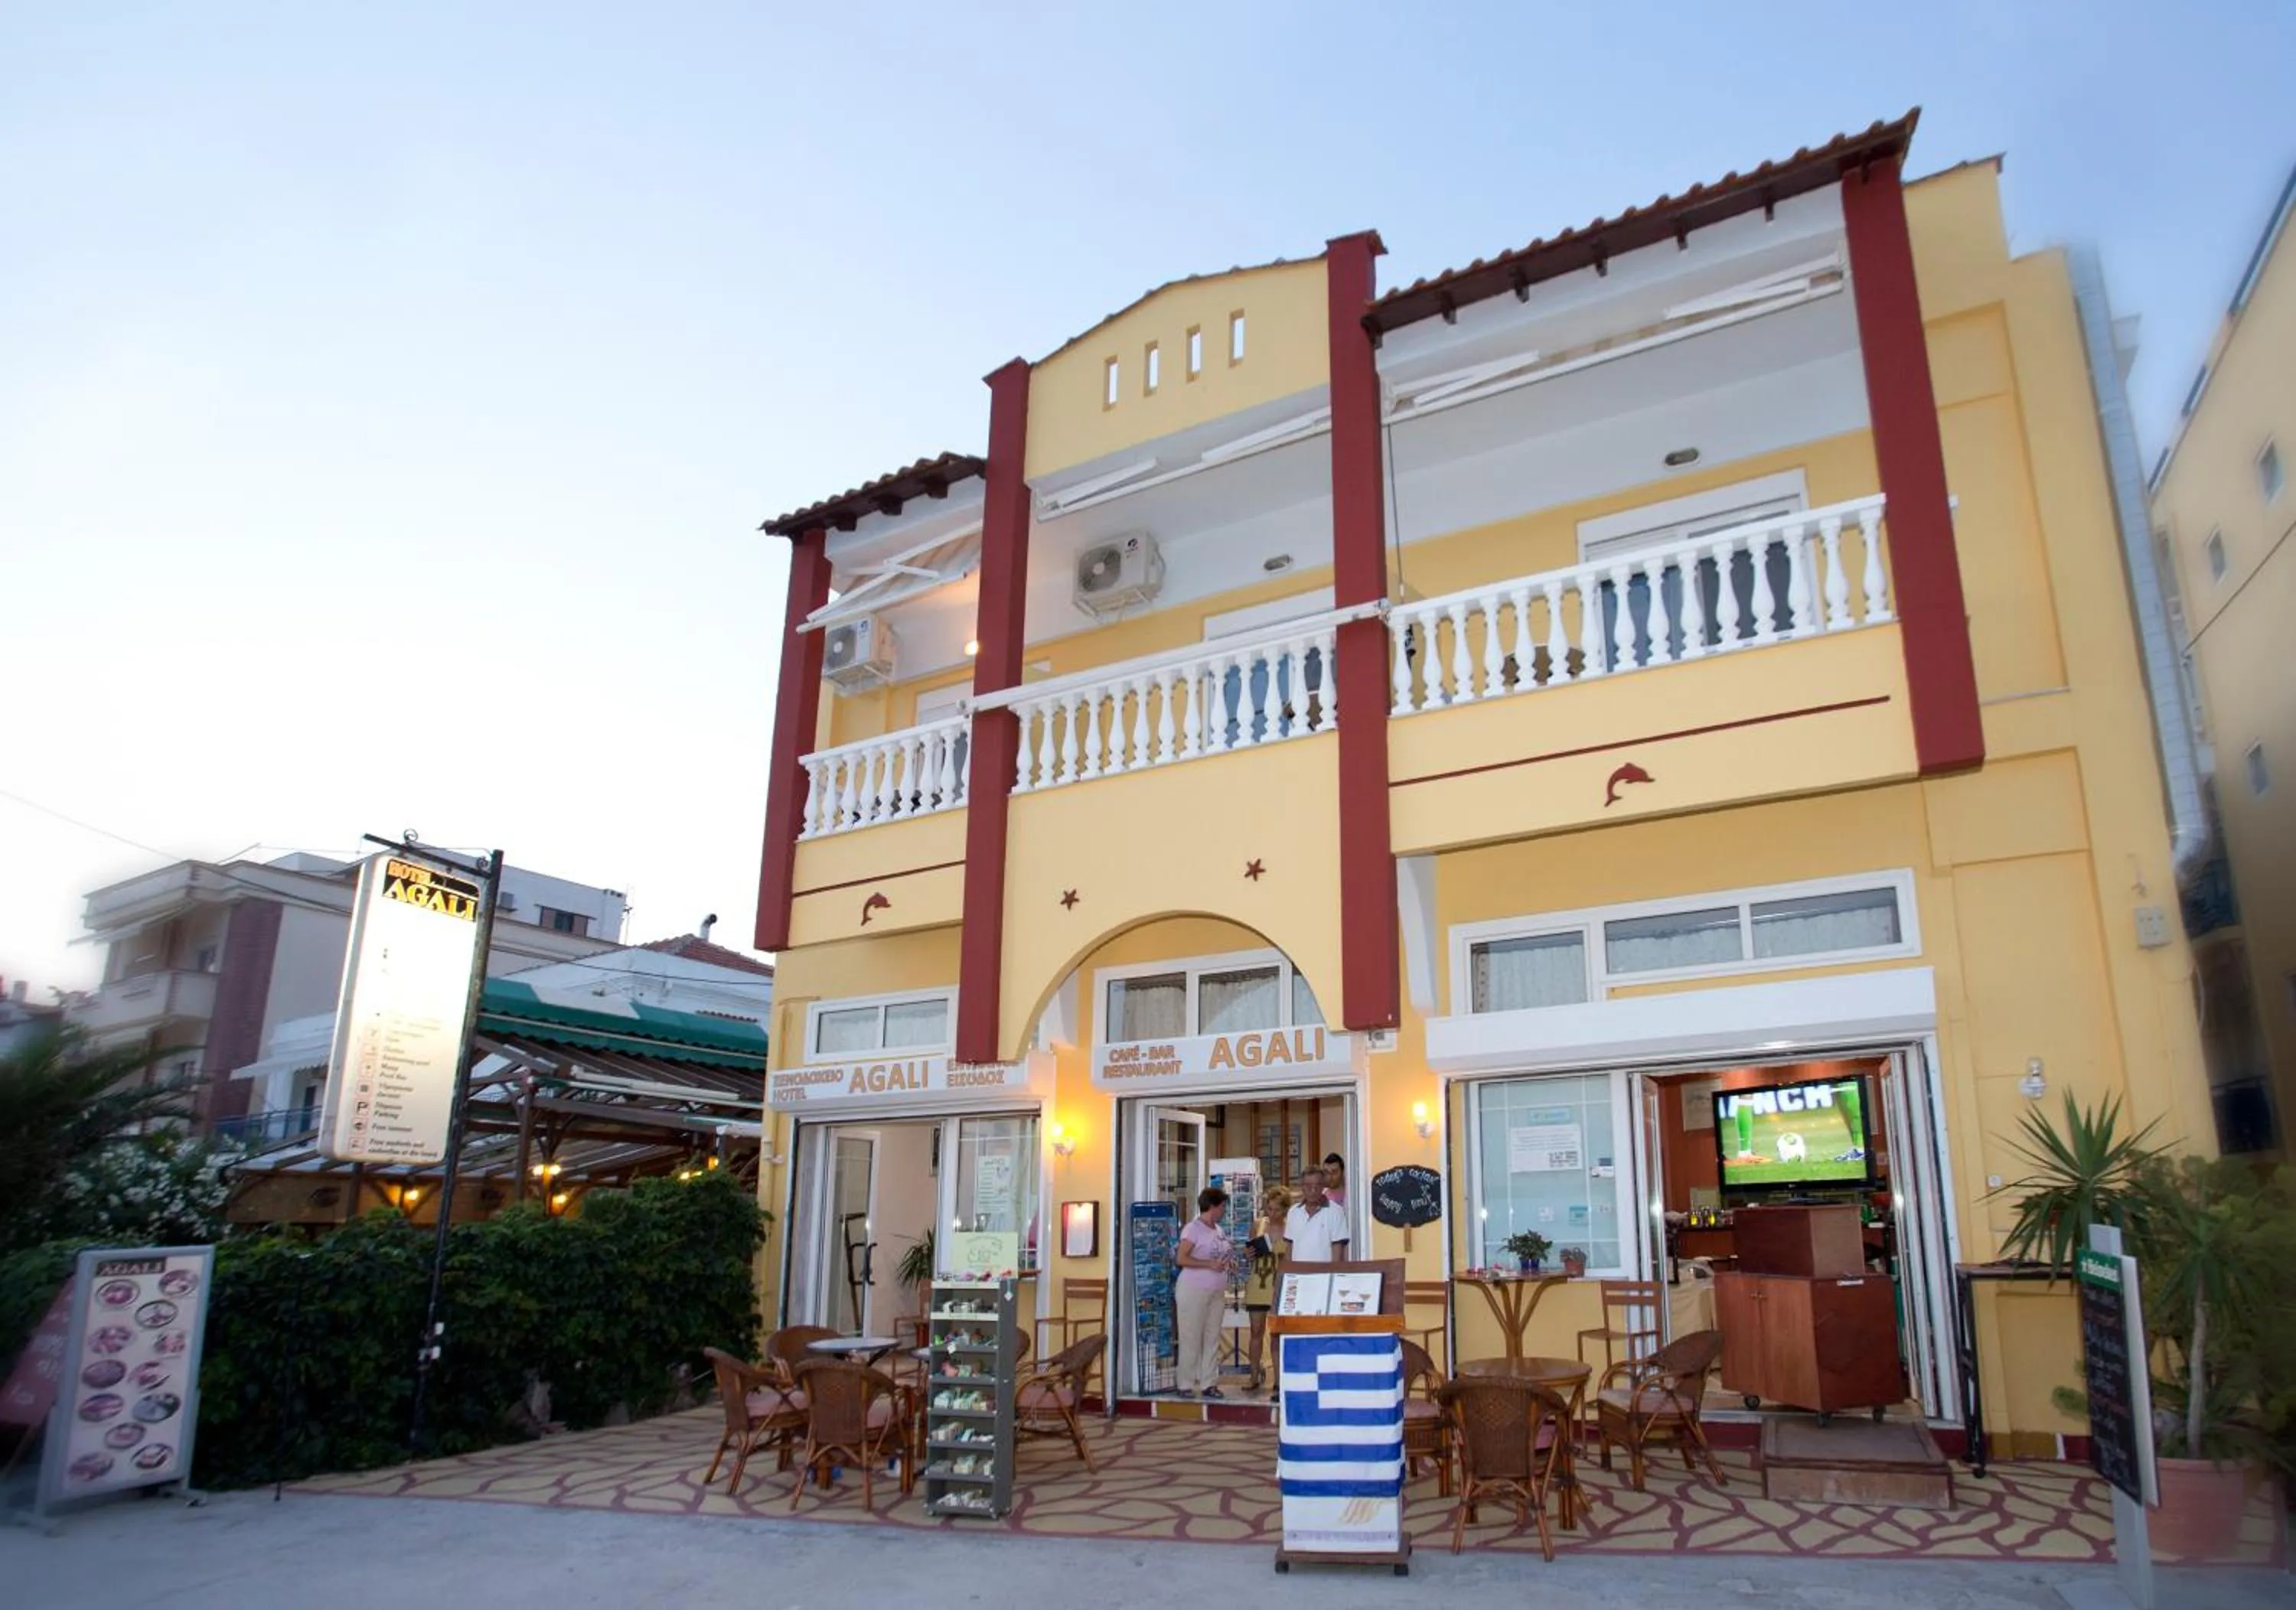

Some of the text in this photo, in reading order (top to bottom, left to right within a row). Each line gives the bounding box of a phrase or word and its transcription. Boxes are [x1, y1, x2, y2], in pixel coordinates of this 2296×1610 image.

[388, 860, 432, 886] HOTEL
[382, 878, 475, 921] AGALI
[1149, 1045, 1175, 1060] BAR
[1208, 1027, 1325, 1070] AGALI
[848, 1060, 929, 1093] AGALI
[1103, 1060, 1182, 1079] RESTAURANT
[773, 1087, 807, 1102] HOTEL
